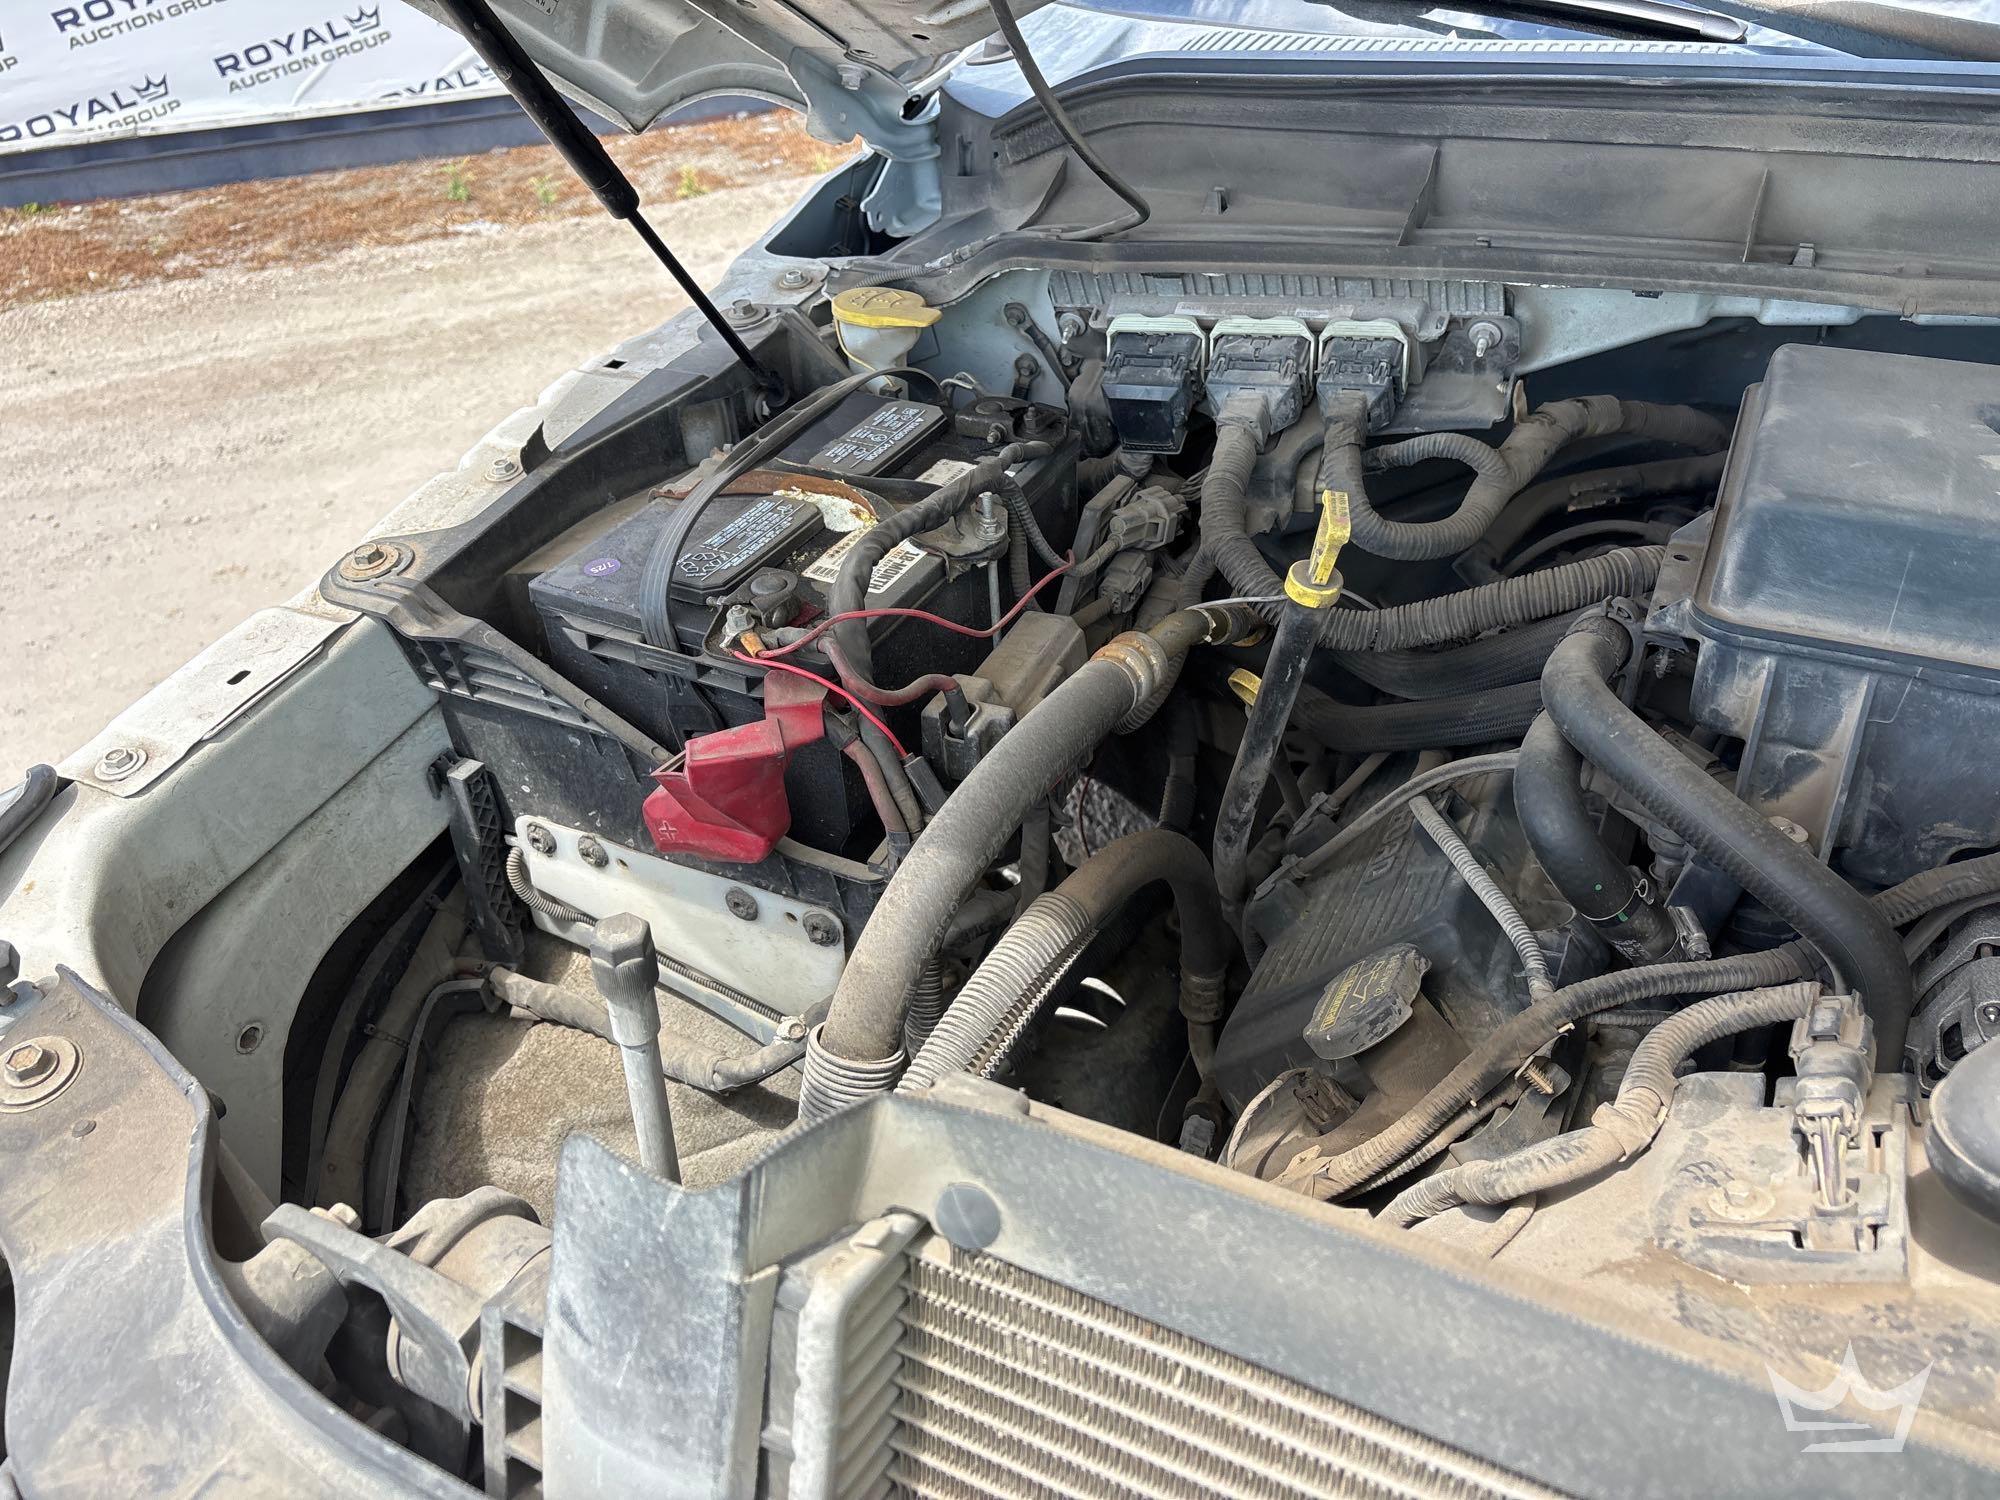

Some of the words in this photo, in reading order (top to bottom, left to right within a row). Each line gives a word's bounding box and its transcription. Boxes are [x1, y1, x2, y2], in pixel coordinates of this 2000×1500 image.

[69, 8, 164, 50] AUCTION
[166, 0, 227, 17] GRO
[214, 20, 350, 77] ROYAL
[228, 54, 318, 93] AUCTION
[320, 30, 392, 63] GROUP
[590, 561, 615, 574] 7/25
[869, 550, 920, 590] 18-MONTH
